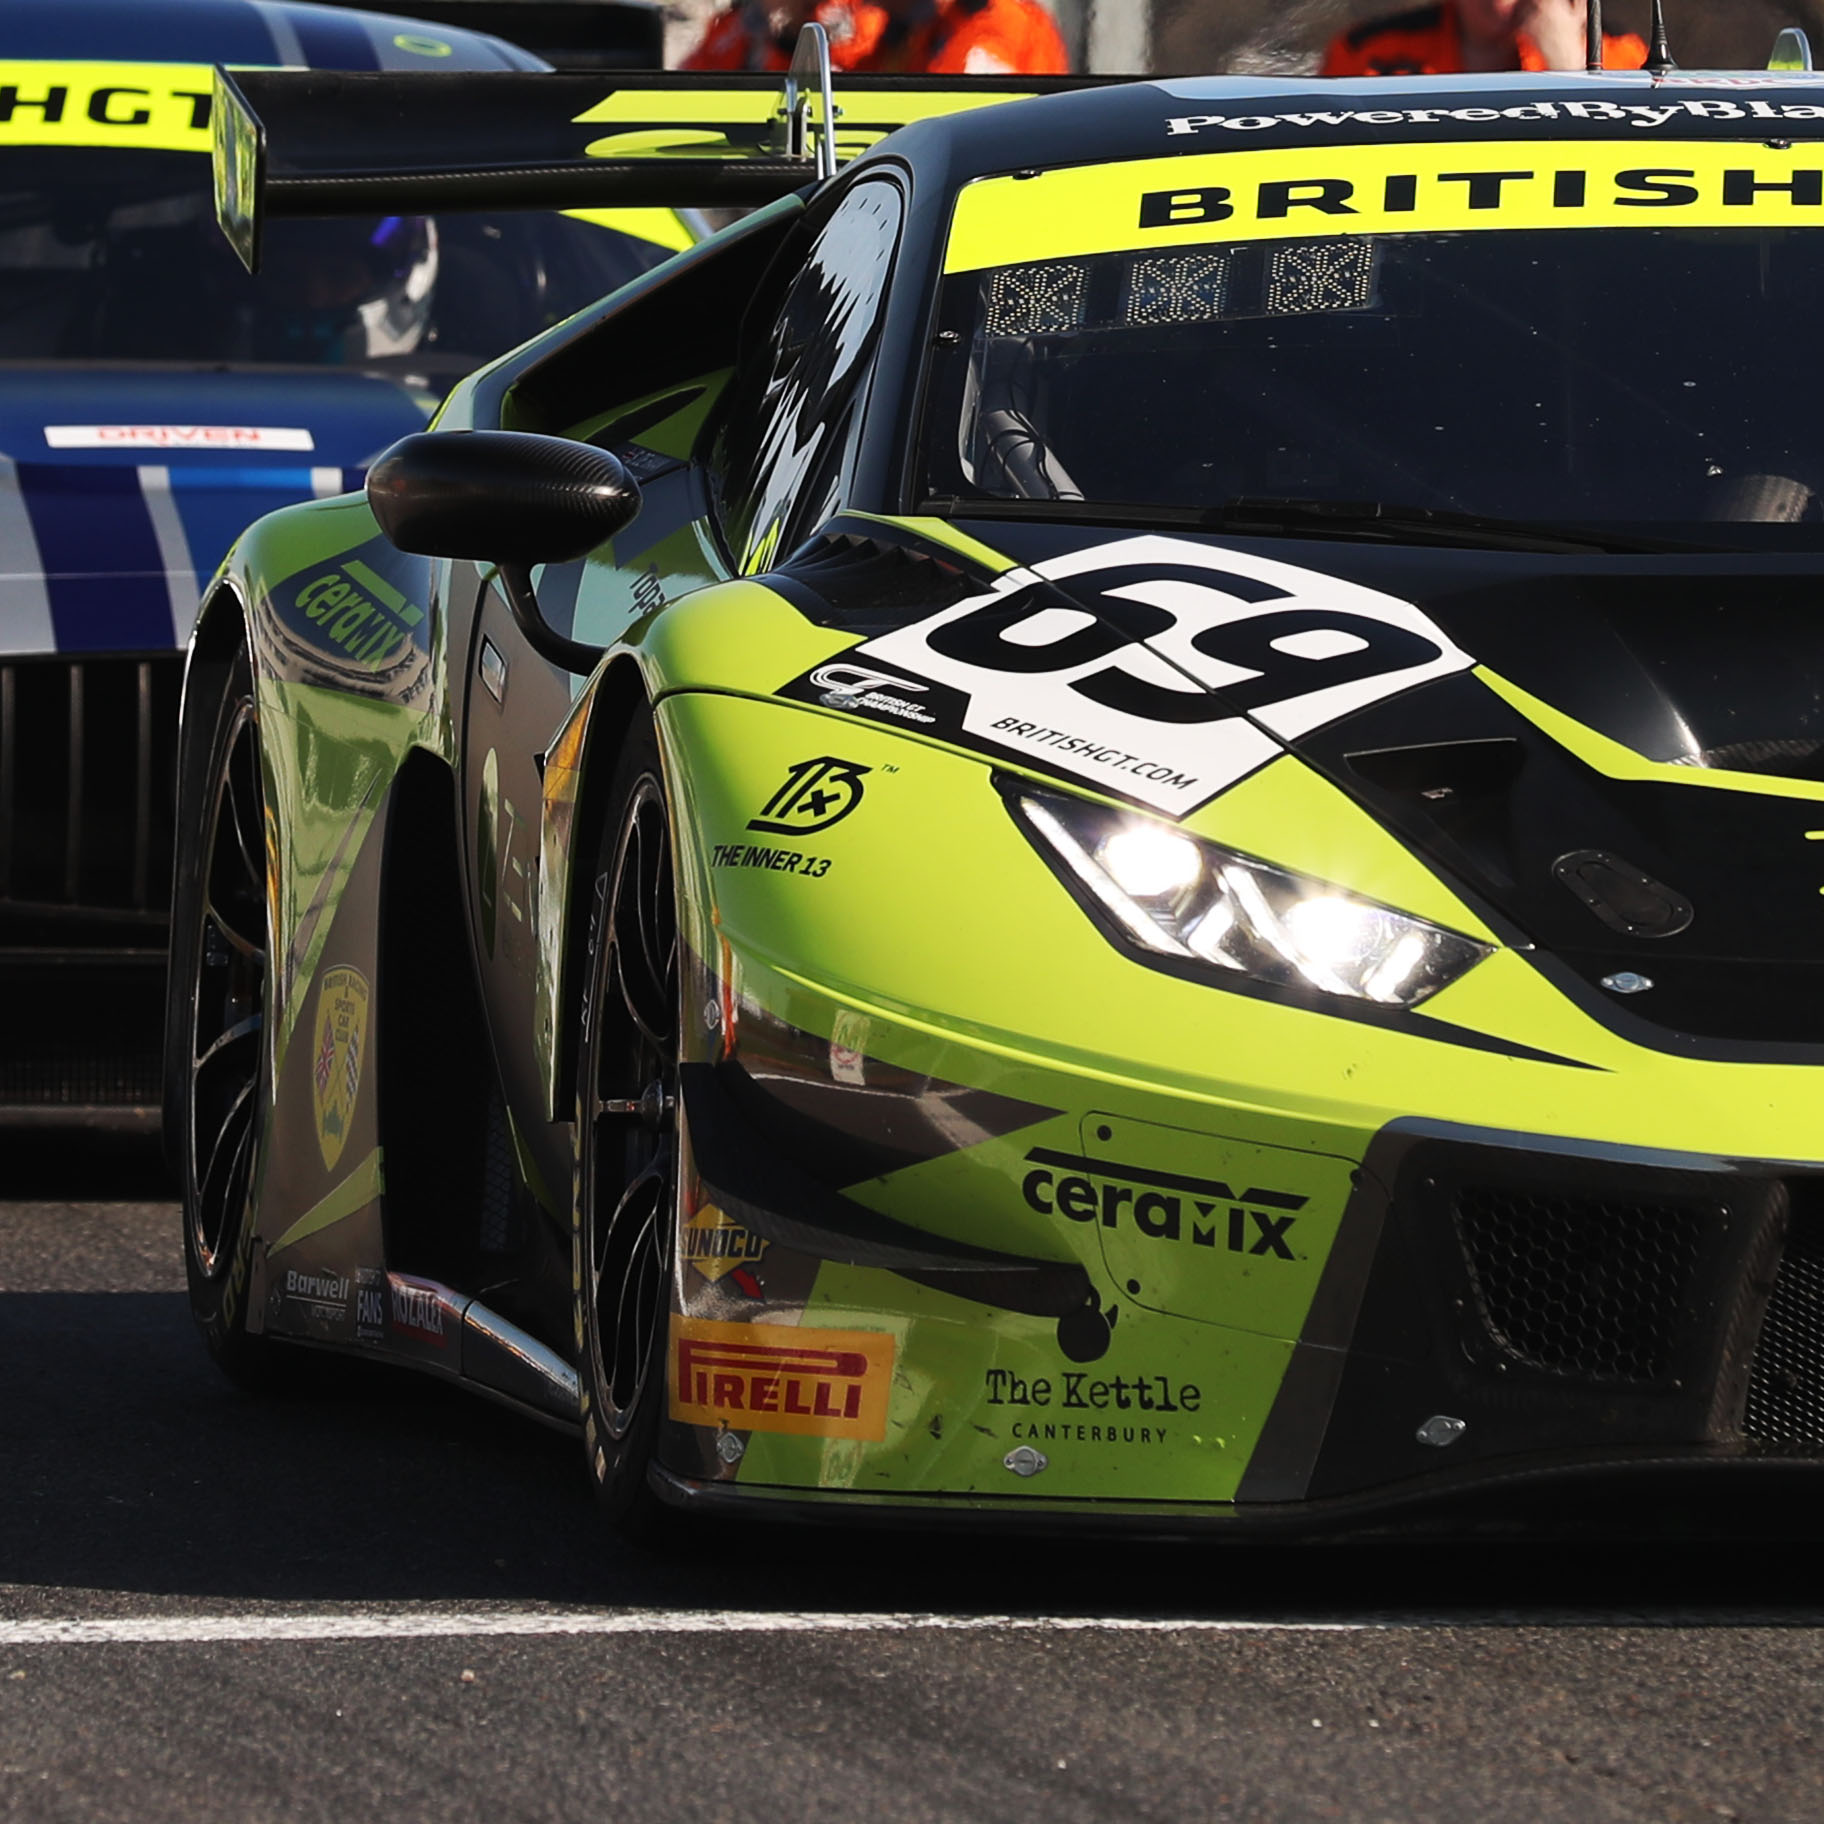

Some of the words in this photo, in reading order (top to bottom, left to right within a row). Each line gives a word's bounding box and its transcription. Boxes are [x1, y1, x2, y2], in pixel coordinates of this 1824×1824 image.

[925, 562, 1444, 725] 69
[989, 716, 1200, 792] BRITISHGT.COM
[712, 844, 745, 867] THE
[741, 846, 803, 872] INNER
[799, 856, 833, 878] 13
[286, 1269, 350, 1301] Barwell
[356, 1289, 384, 1326] FANS
[678, 1338, 868, 1419] PIRELLI
[987, 1369, 1053, 1411] The
[1061, 1373, 1203, 1414] Kettle
[1011, 1421, 1168, 1445] CANTERBURY
